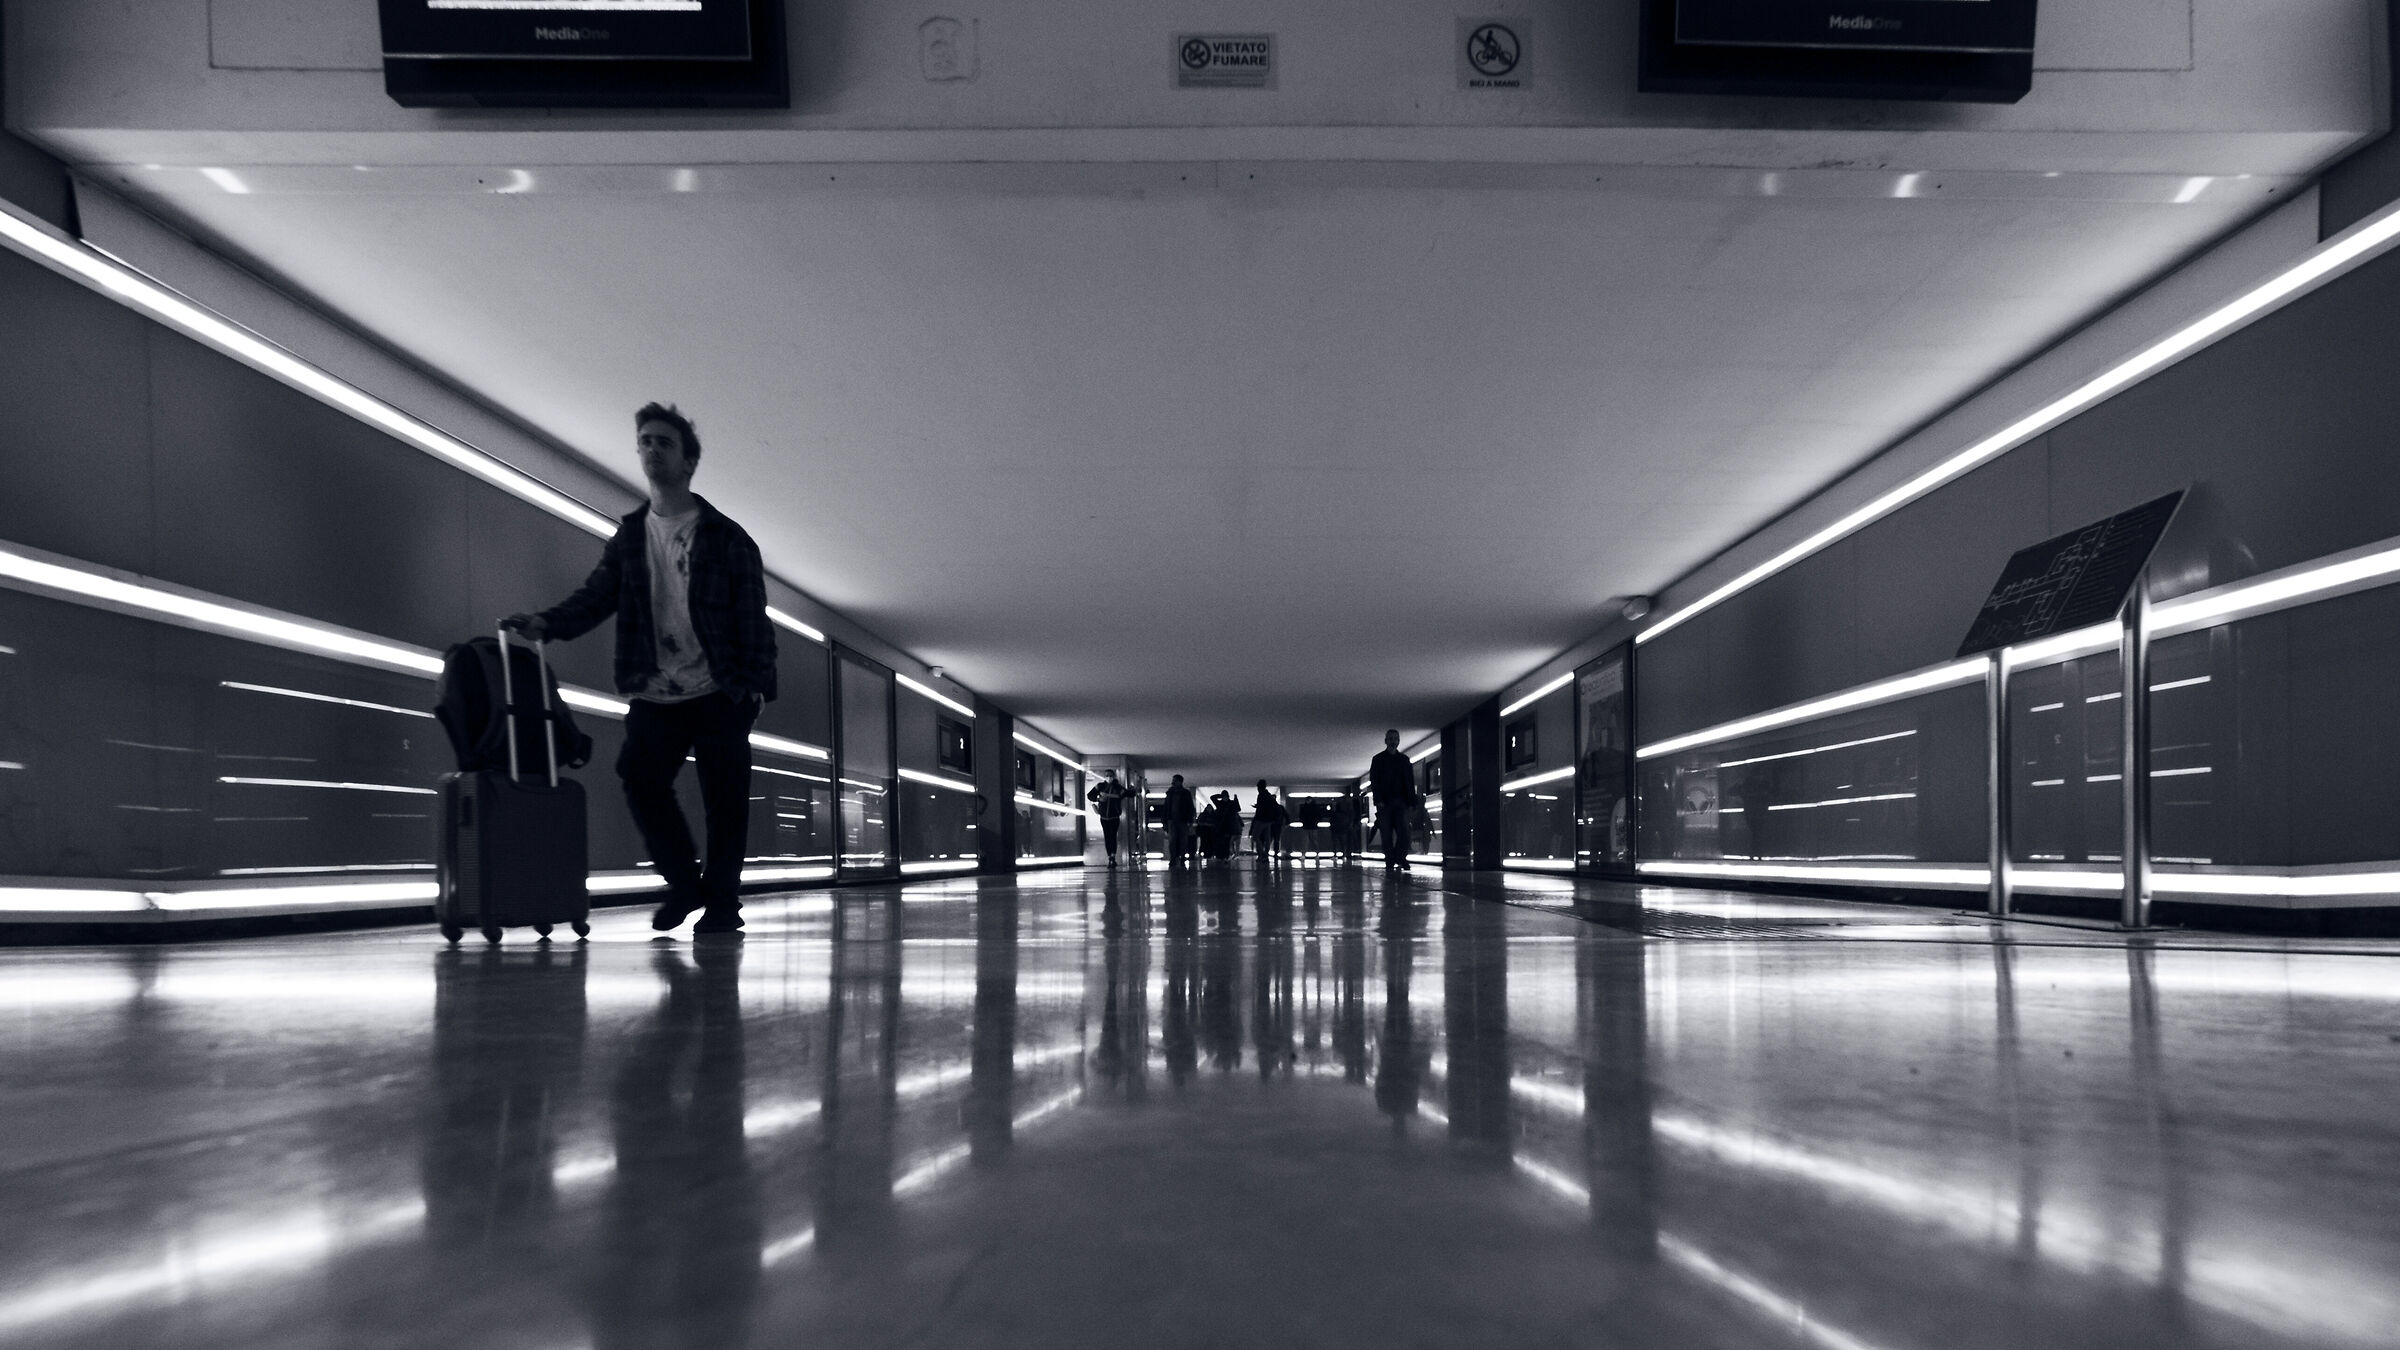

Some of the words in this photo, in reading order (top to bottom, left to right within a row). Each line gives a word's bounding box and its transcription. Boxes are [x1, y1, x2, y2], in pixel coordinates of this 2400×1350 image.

[1829, 15, 1902, 31] MediaOne
[535, 26, 610, 40] MediaOne
[1213, 42, 1266, 53] VIETATO
[1213, 55, 1266, 66] FUMARE
[1494, 80, 1520, 88] MANO
